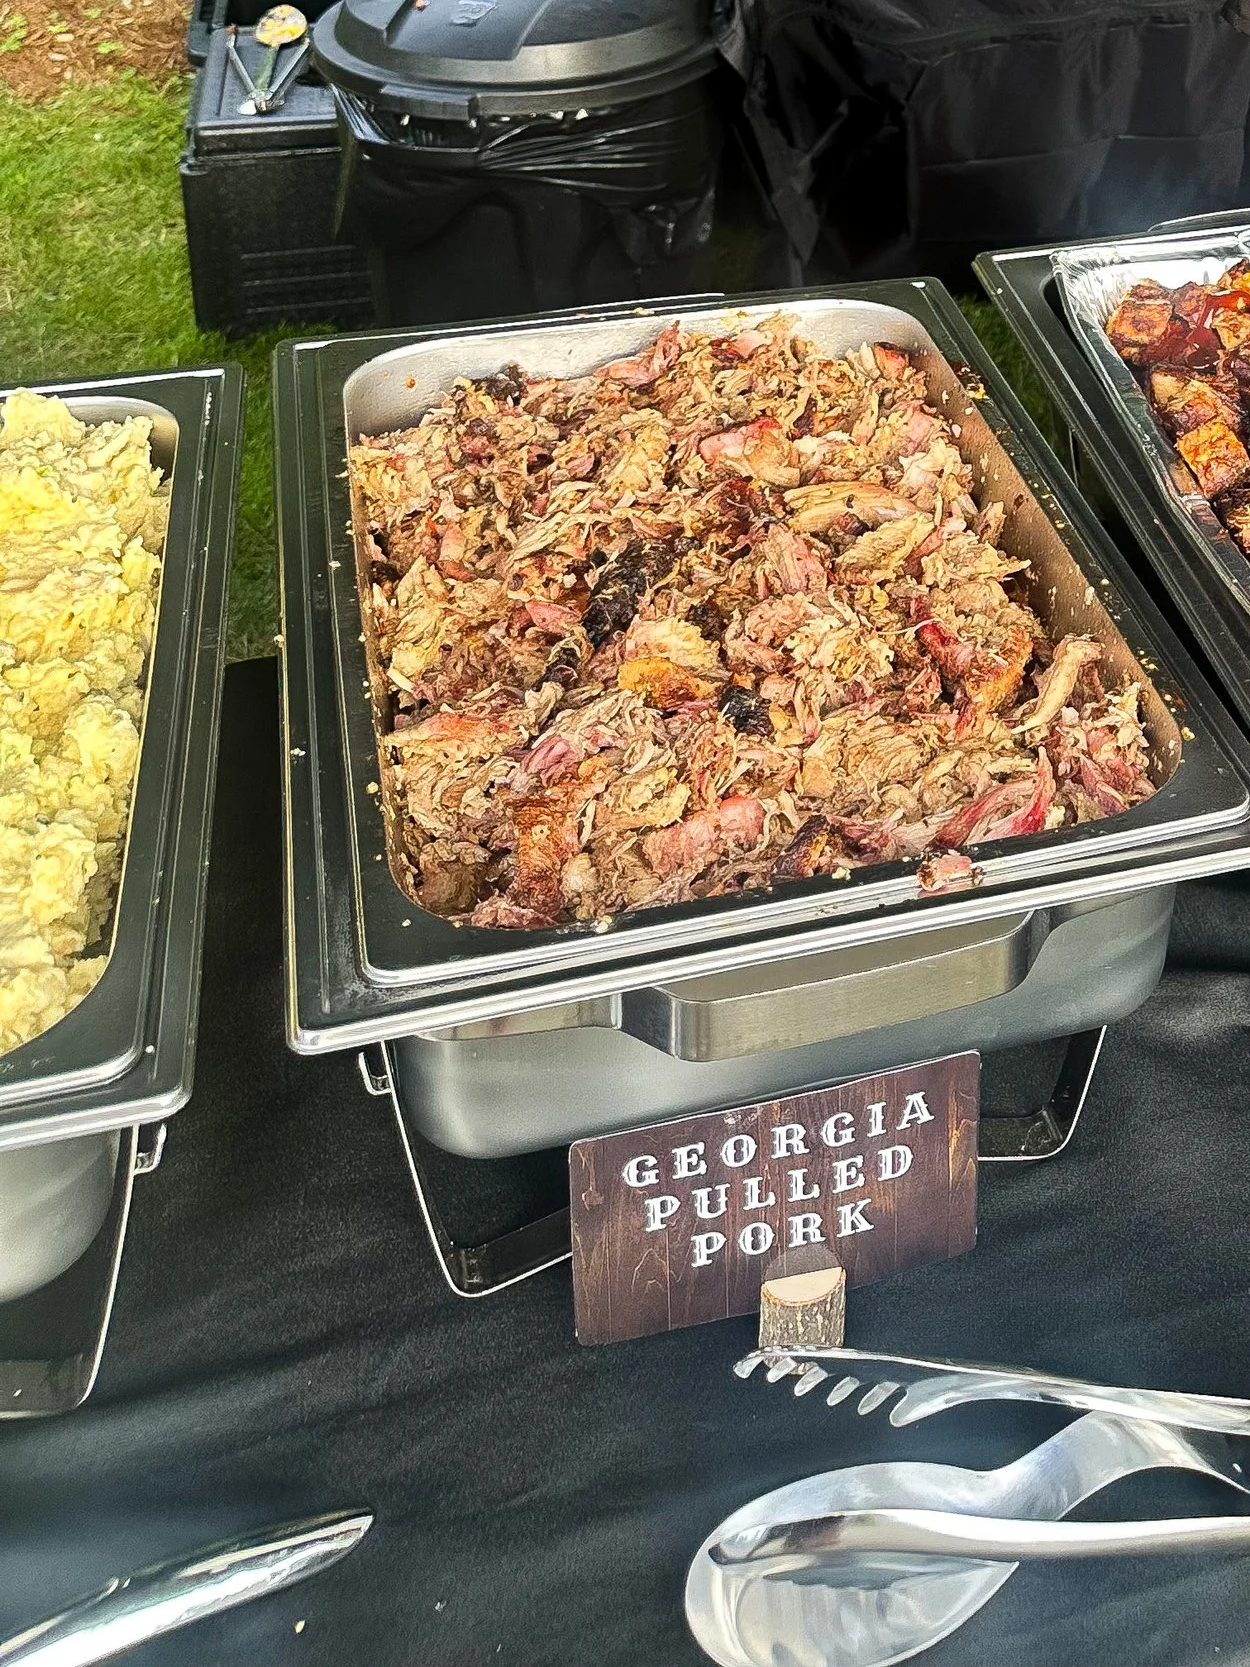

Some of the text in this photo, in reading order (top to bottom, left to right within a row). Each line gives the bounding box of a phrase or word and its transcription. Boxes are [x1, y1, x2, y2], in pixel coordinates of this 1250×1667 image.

[621, 1091, 935, 1188] GEORGIA
[644, 1144, 914, 1233] PULLED
[690, 1198, 875, 1268] PORK
